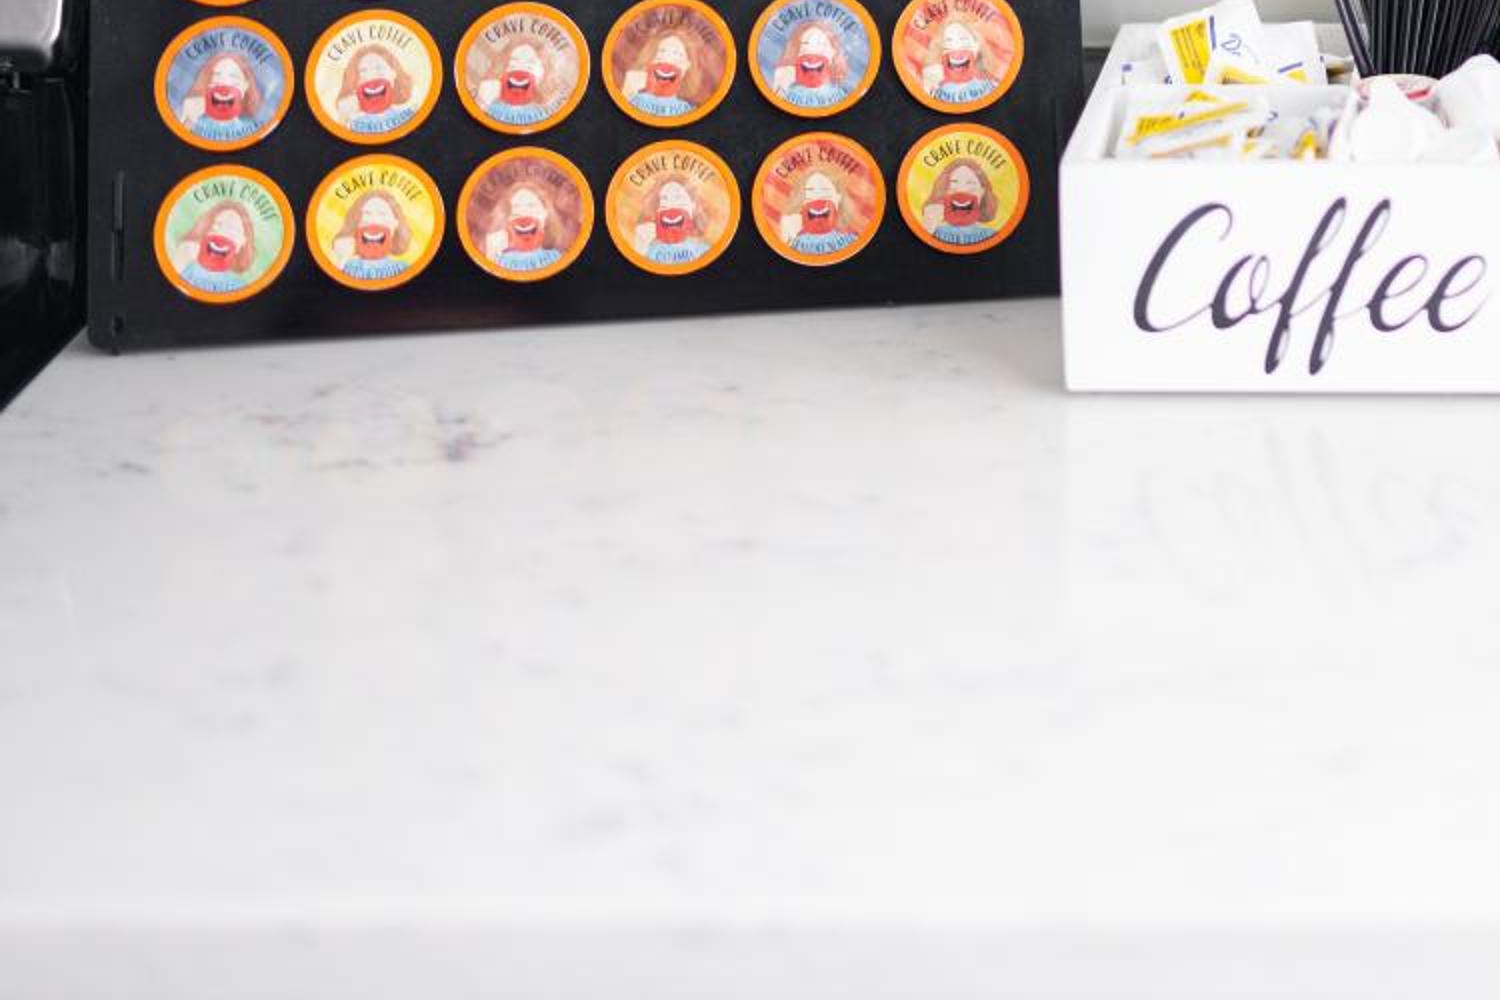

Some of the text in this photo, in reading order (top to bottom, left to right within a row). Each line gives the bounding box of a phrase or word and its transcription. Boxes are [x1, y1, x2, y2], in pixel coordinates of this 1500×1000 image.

[773, 2, 856, 32] CRAVE COFFEE
[186, 34, 225, 60] CRAVE
[328, 24, 413, 61] CRAVE COFFEE
[485, 19, 570, 51] CRAVE COFFEE
[923, 139, 1007, 169] CRAVE COFFEE
[629, 154, 715, 186] CRAVE COFFEE
[193, 181, 235, 204] CRAVE
[335, 171, 422, 201] CRAVE COFFEE
[1132, 196, 1490, 375] Coffee
